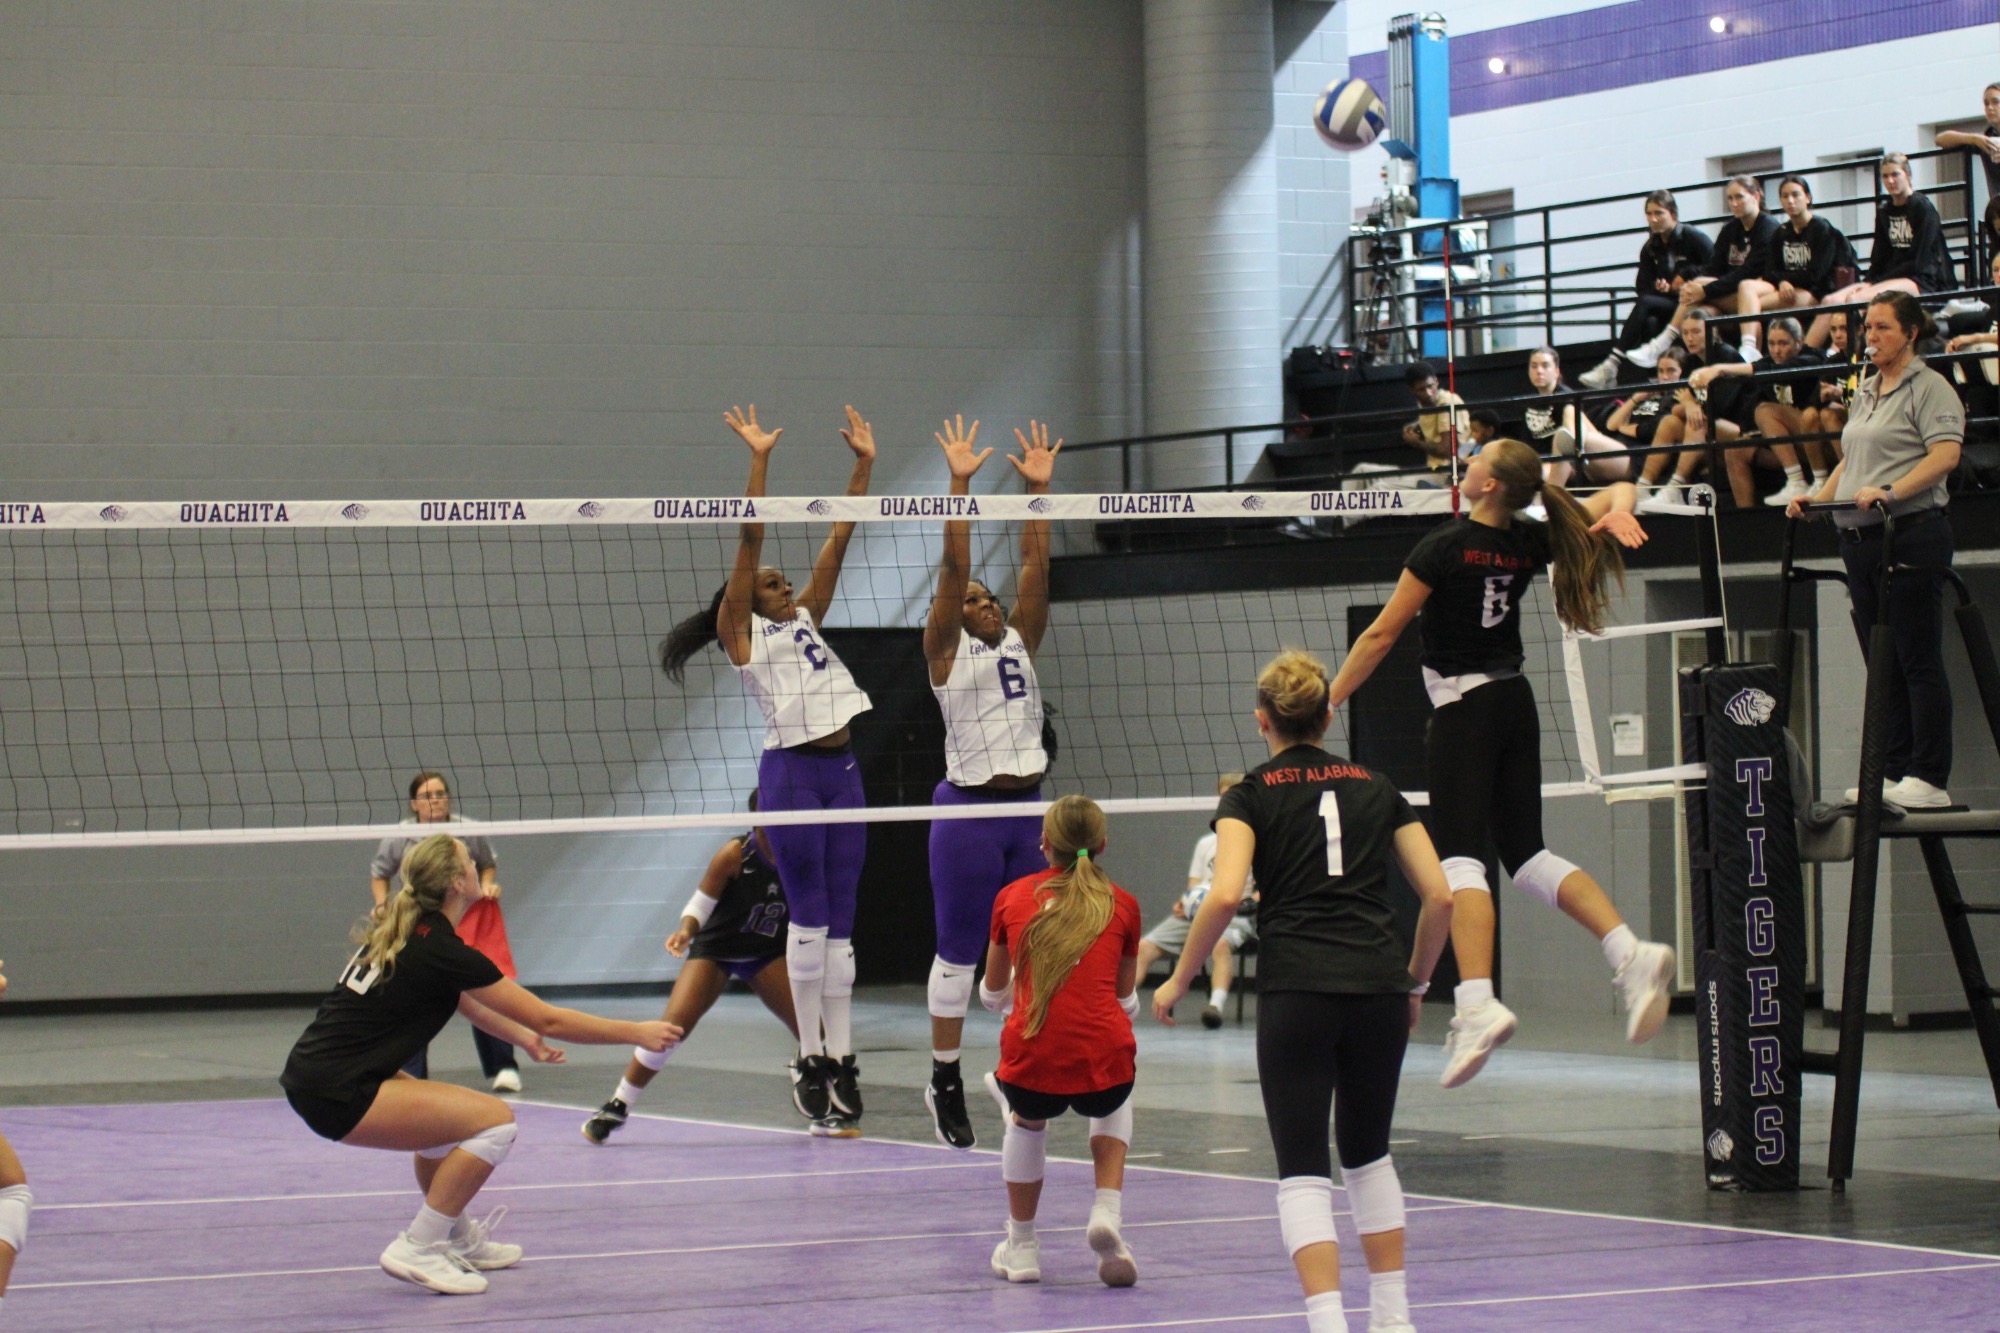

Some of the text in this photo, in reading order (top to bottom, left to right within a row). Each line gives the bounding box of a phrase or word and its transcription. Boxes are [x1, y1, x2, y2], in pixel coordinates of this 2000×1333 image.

[420, 502, 526, 522] OUACHITA
[655, 500, 756, 519] OUACHITA
[881, 497, 979, 516] OUACHITA
[1100, 495, 1194, 514] OUACHITA
[1311, 493, 1403, 511] OUACHITA
[180, 503, 288, 523] OUACHITA
[1463, 549, 1491, 566] WEST
[794, 628, 828, 671] 2
[997, 656, 1028, 700] 6
[1263, 765, 1372, 786] WEST ALABAMA
[1318, 790, 1344, 876] 1
[740, 902, 786, 938] 12
[1736, 757, 1785, 1166] TIGERS
[1708, 980, 1723, 1107] sports imports
